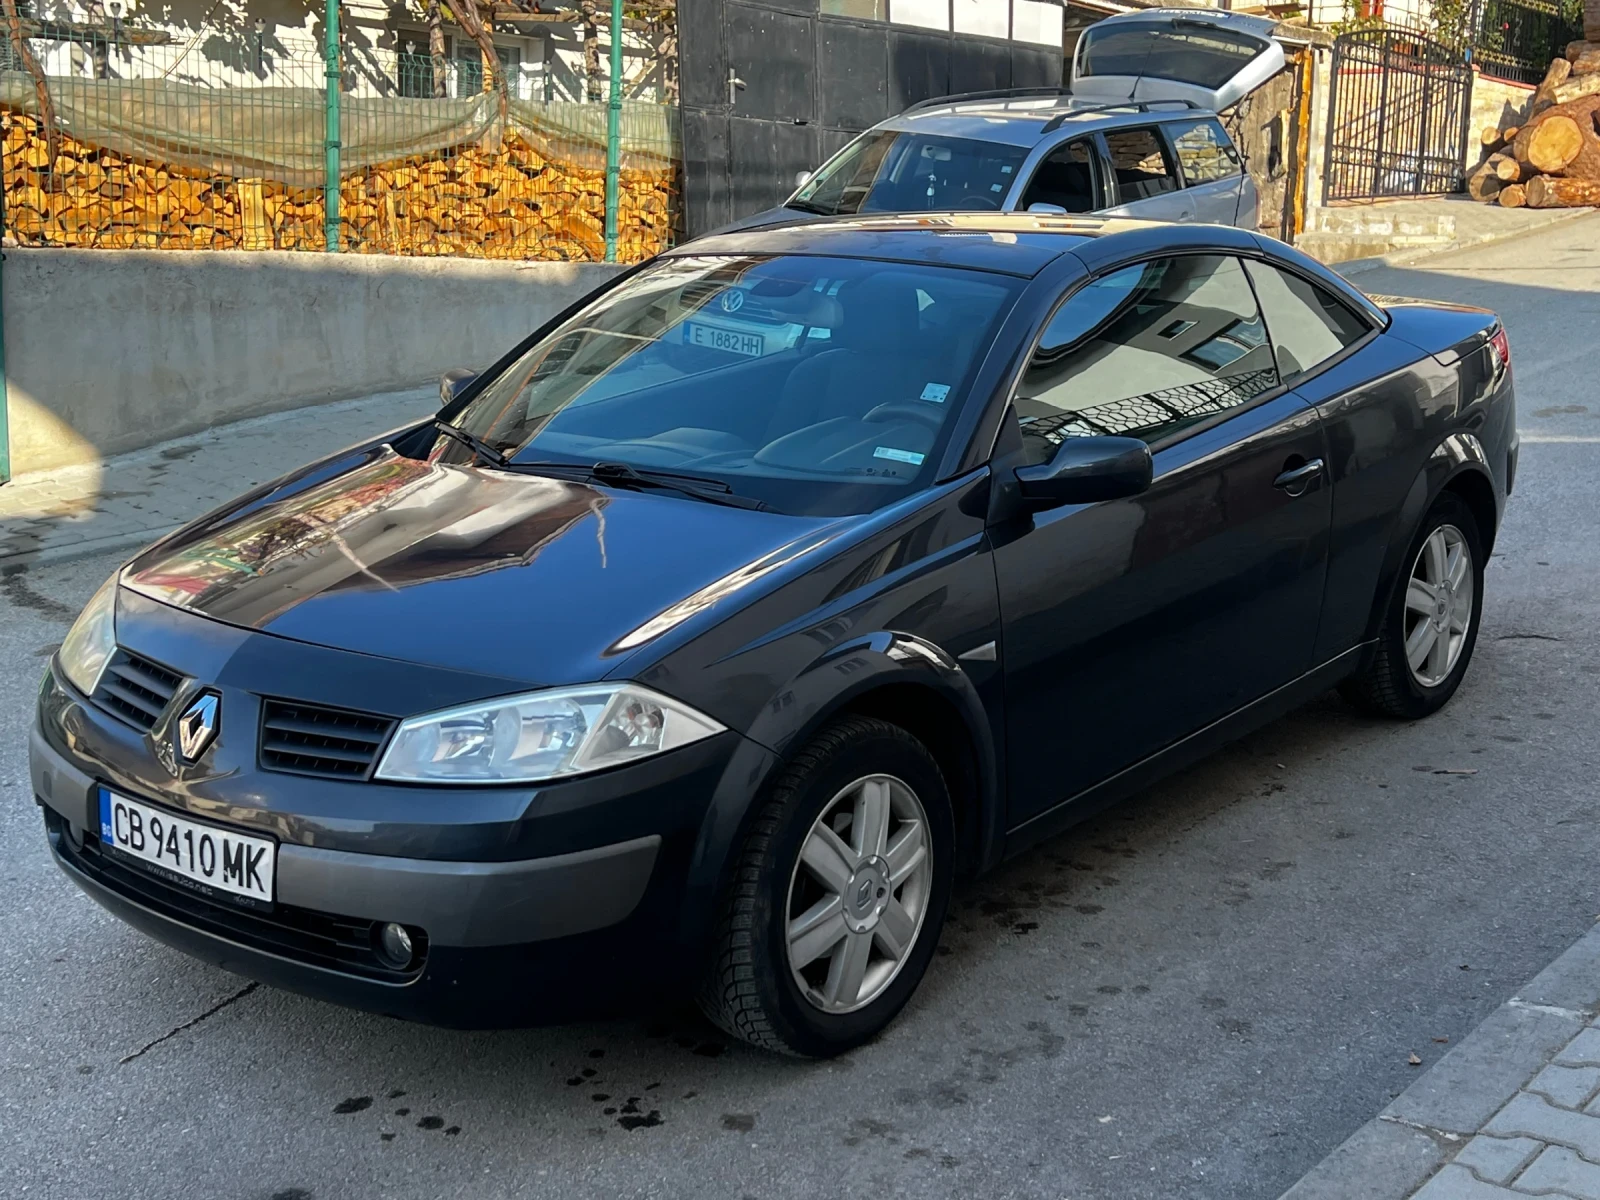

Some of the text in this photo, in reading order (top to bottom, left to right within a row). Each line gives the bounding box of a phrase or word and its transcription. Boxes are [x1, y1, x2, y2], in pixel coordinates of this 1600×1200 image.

[695, 327, 703, 344] E
[710, 330, 739, 351] 1882
[741, 336, 759, 355] HH
[115, 803, 267, 894] CB 9410 MK
